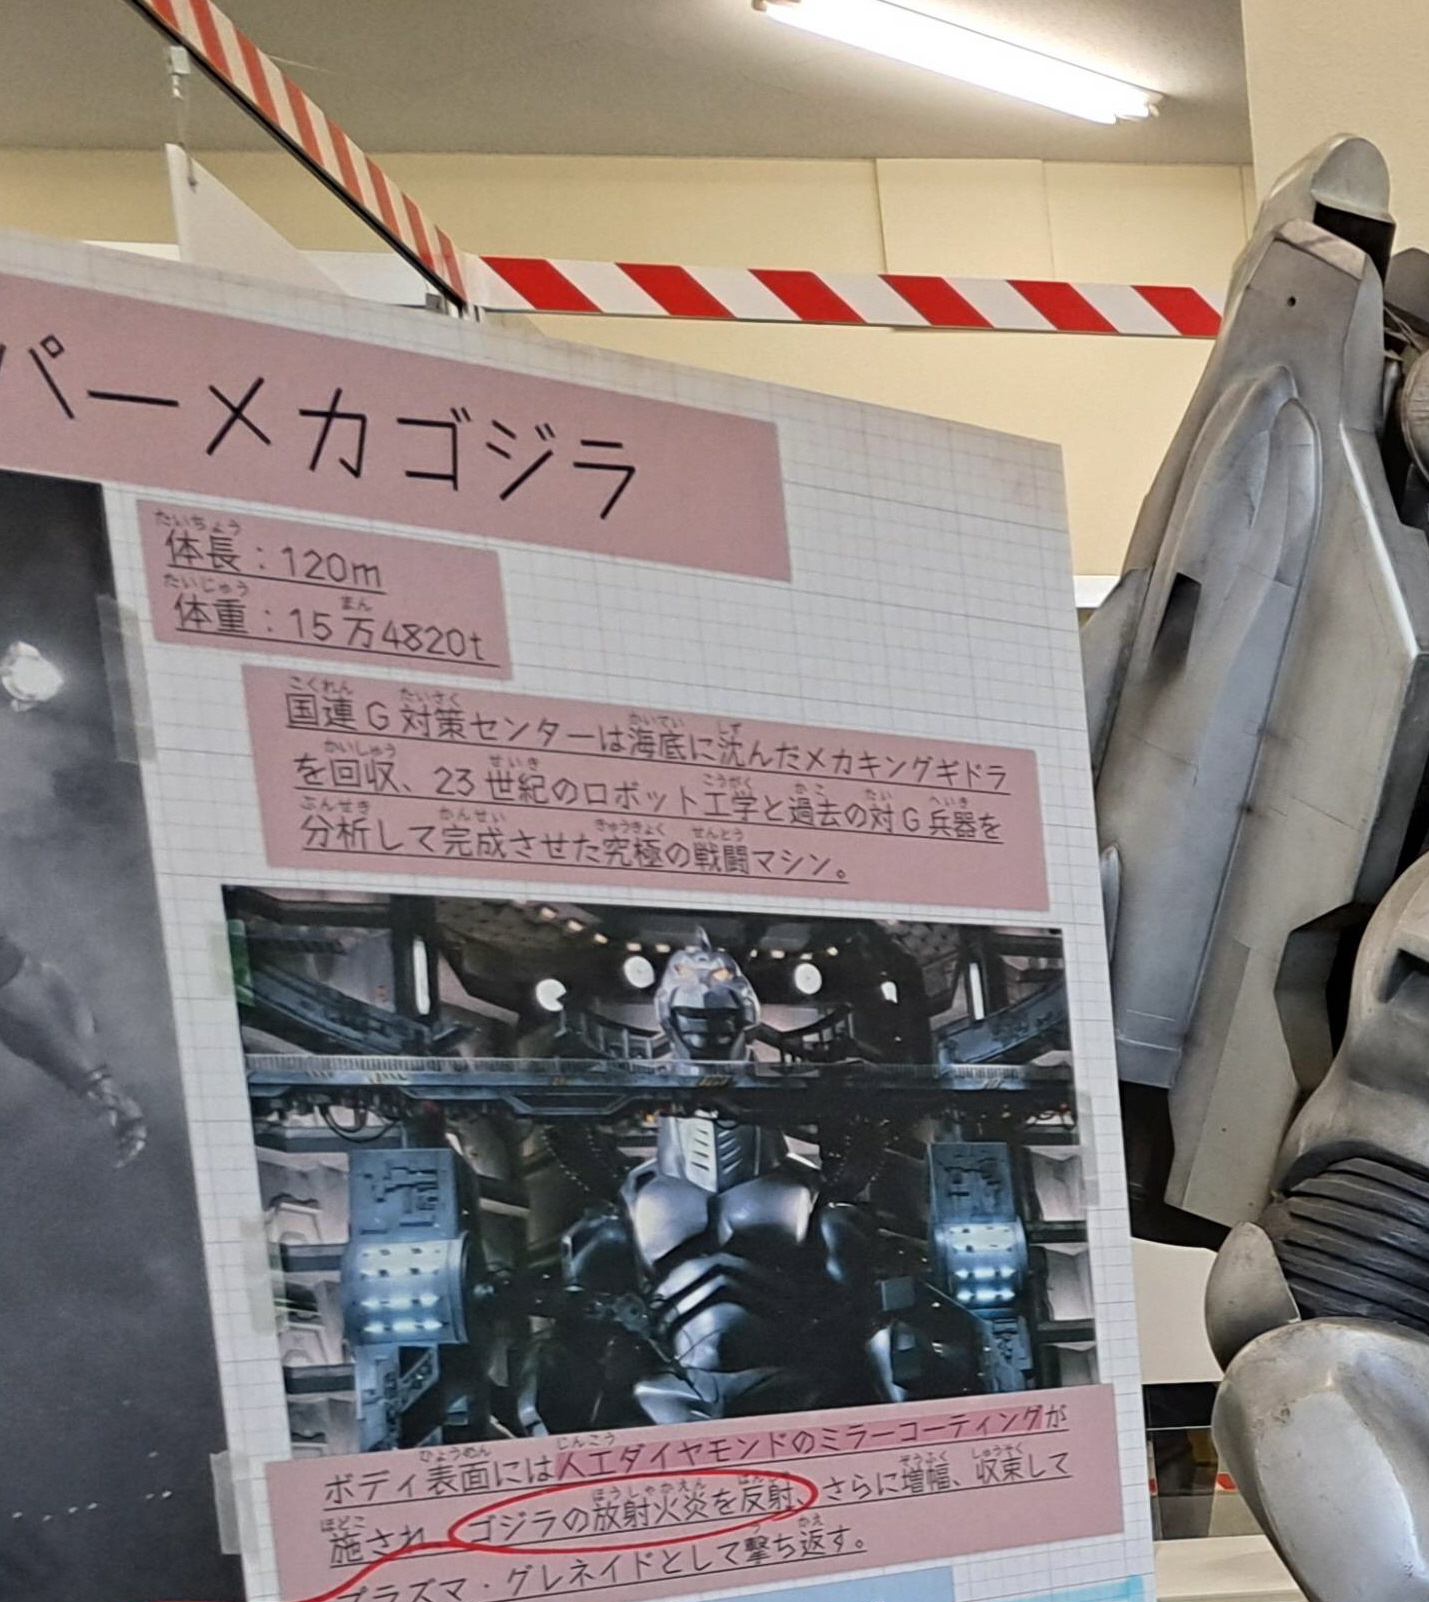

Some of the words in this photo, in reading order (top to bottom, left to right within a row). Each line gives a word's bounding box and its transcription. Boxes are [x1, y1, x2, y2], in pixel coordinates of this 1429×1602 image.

[329, 1452, 1070, 1564] 施されゴジラの放射火炎を反射、さらに増幅、収束して
